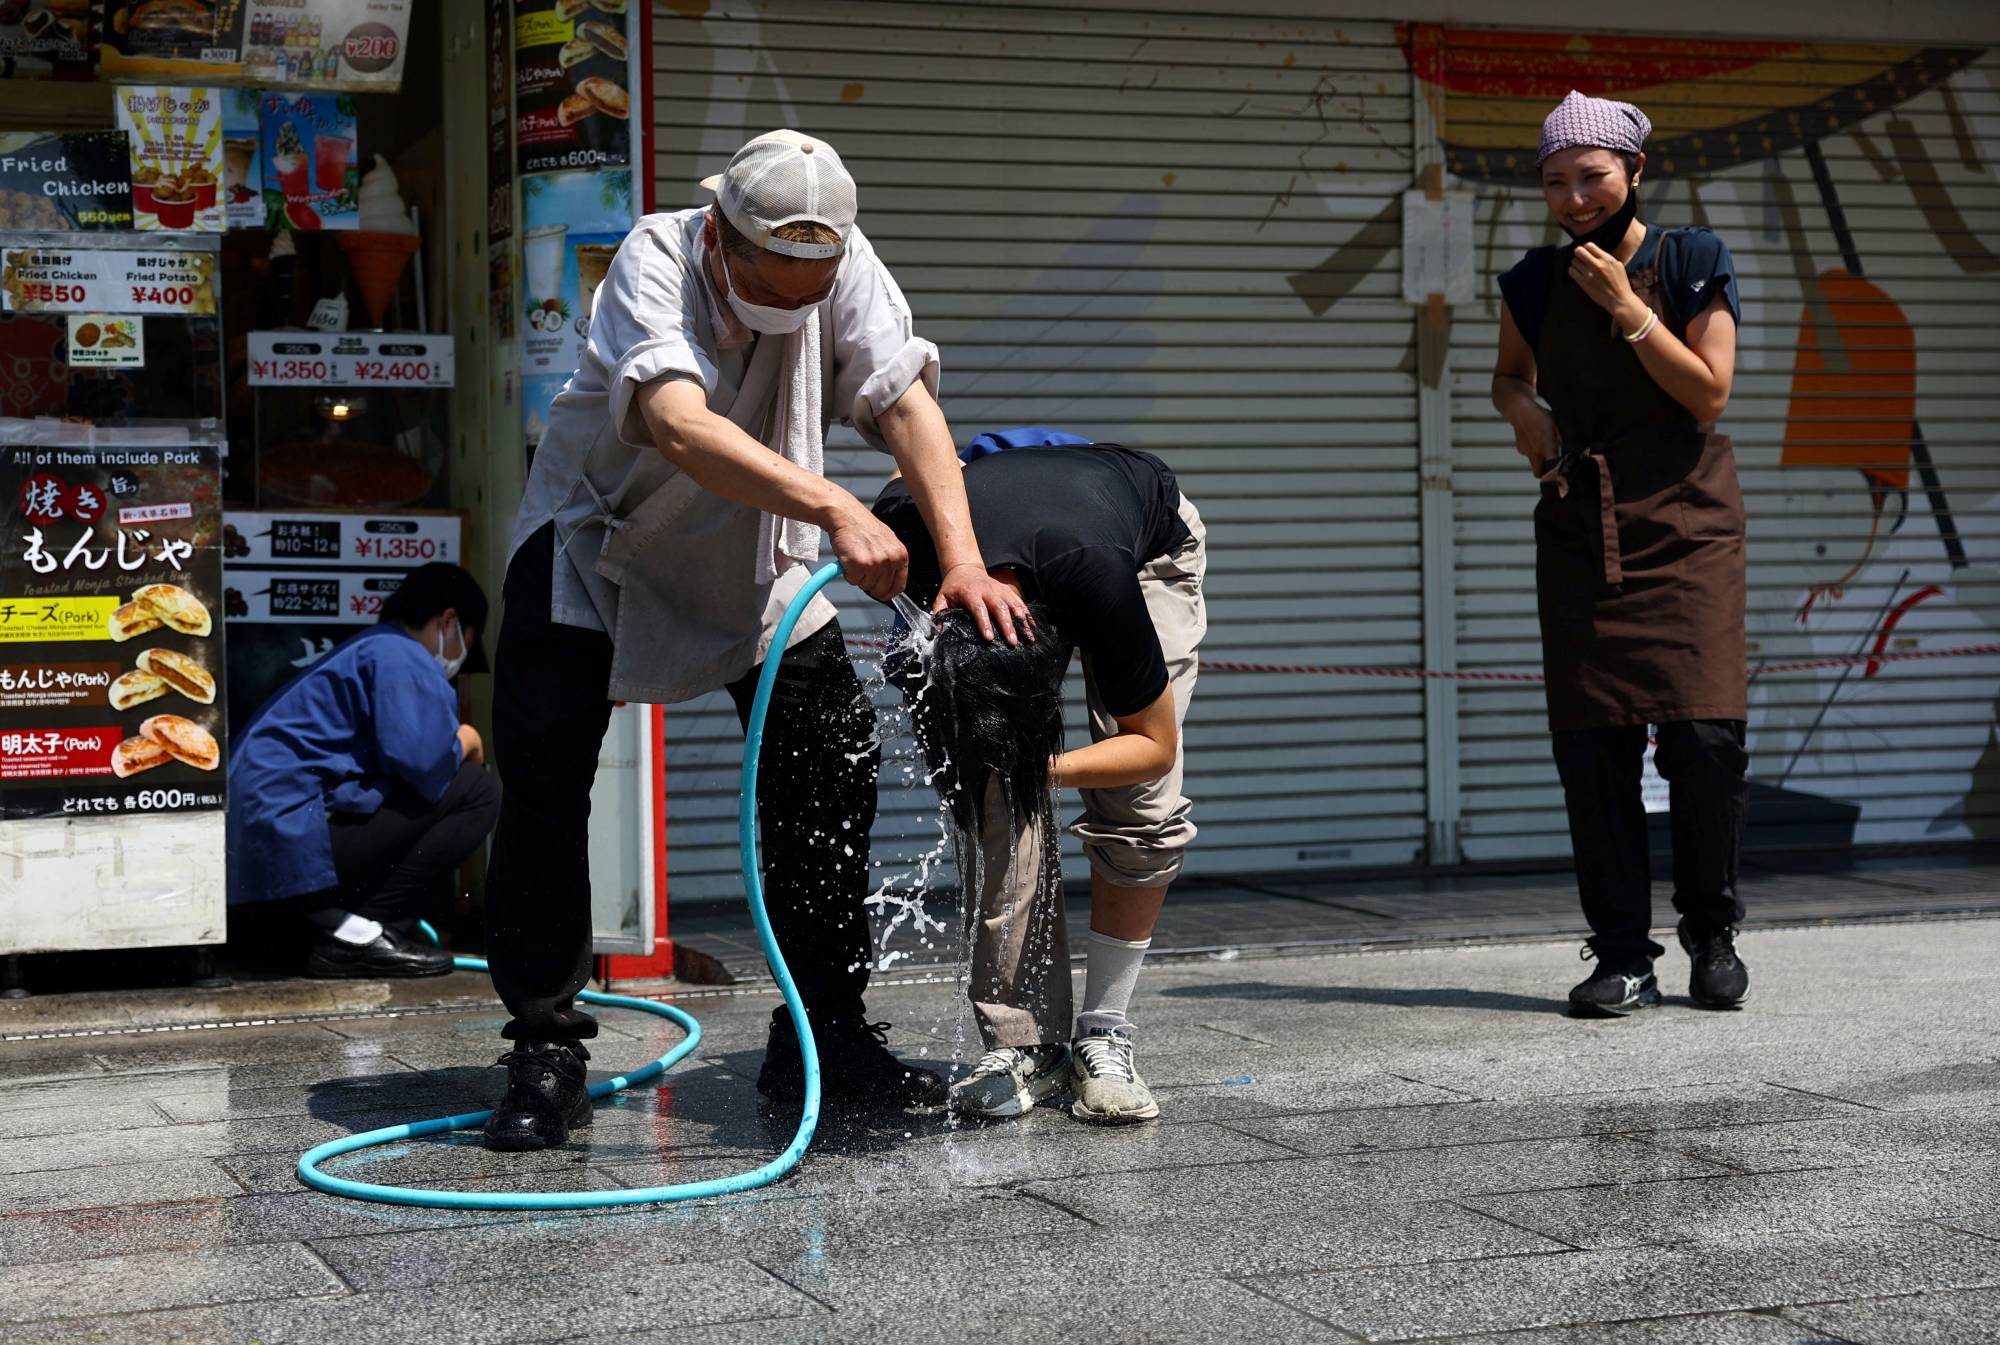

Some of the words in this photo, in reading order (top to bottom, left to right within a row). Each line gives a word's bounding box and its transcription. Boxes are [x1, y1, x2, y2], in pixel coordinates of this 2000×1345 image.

[0, 156, 68, 172] Fried
[42, 179, 131, 197] Chicken
[18, 271, 48, 279] Fried
[51, 271, 97, 280] Chicken
[126, 273, 155, 281] Fried
[159, 274, 198, 282] Potato
[23, 284, 85, 302] ¥550
[132, 287, 193, 304] ¥400
[254, 361, 327, 379] ¥1,350
[355, 361, 430, 380] ¥2,400
[13, 452, 32, 464] All
[36, 452, 52, 464] of
[57, 452, 96, 464] them
[101, 452, 159, 464] include
[164, 452, 200, 464] Pork
[25, 479, 101, 519] 焼き
[22, 526, 194, 574] もんじゃ
[355, 538, 436, 559] ¥1,350
[350, 595, 382, 615] ¥2
[2, 733, 101, 755] 明太子(Pork)
[62, 797, 119, 813] どれでも
